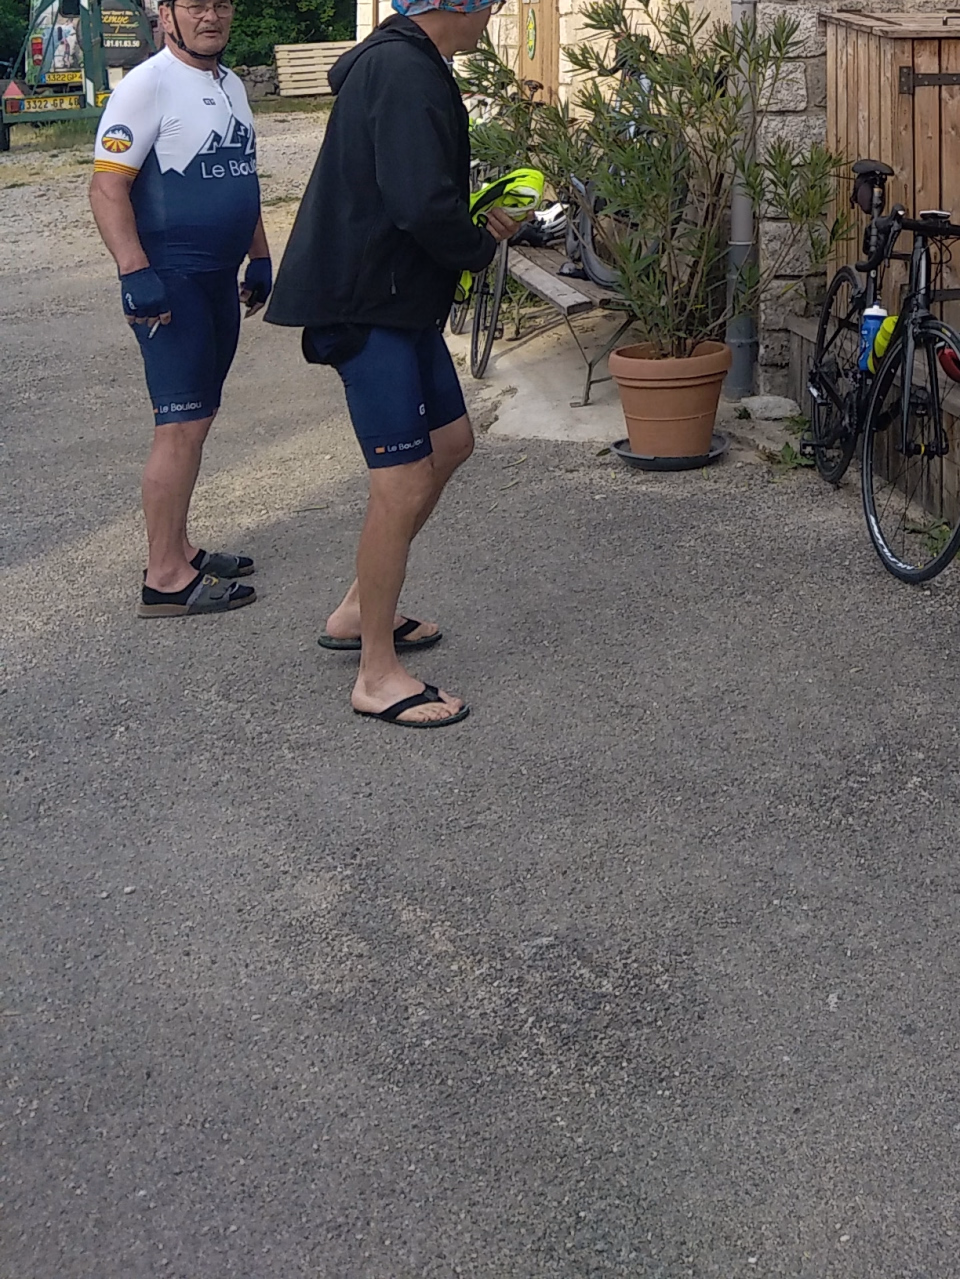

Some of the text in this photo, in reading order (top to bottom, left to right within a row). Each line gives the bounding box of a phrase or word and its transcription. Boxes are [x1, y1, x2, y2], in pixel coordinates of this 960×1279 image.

[26, 99, 48, 110] 3322
[201, 162, 226, 178] Le
[159, 401, 203, 414] Le Boulou
[387, 444, 398, 453] Le
